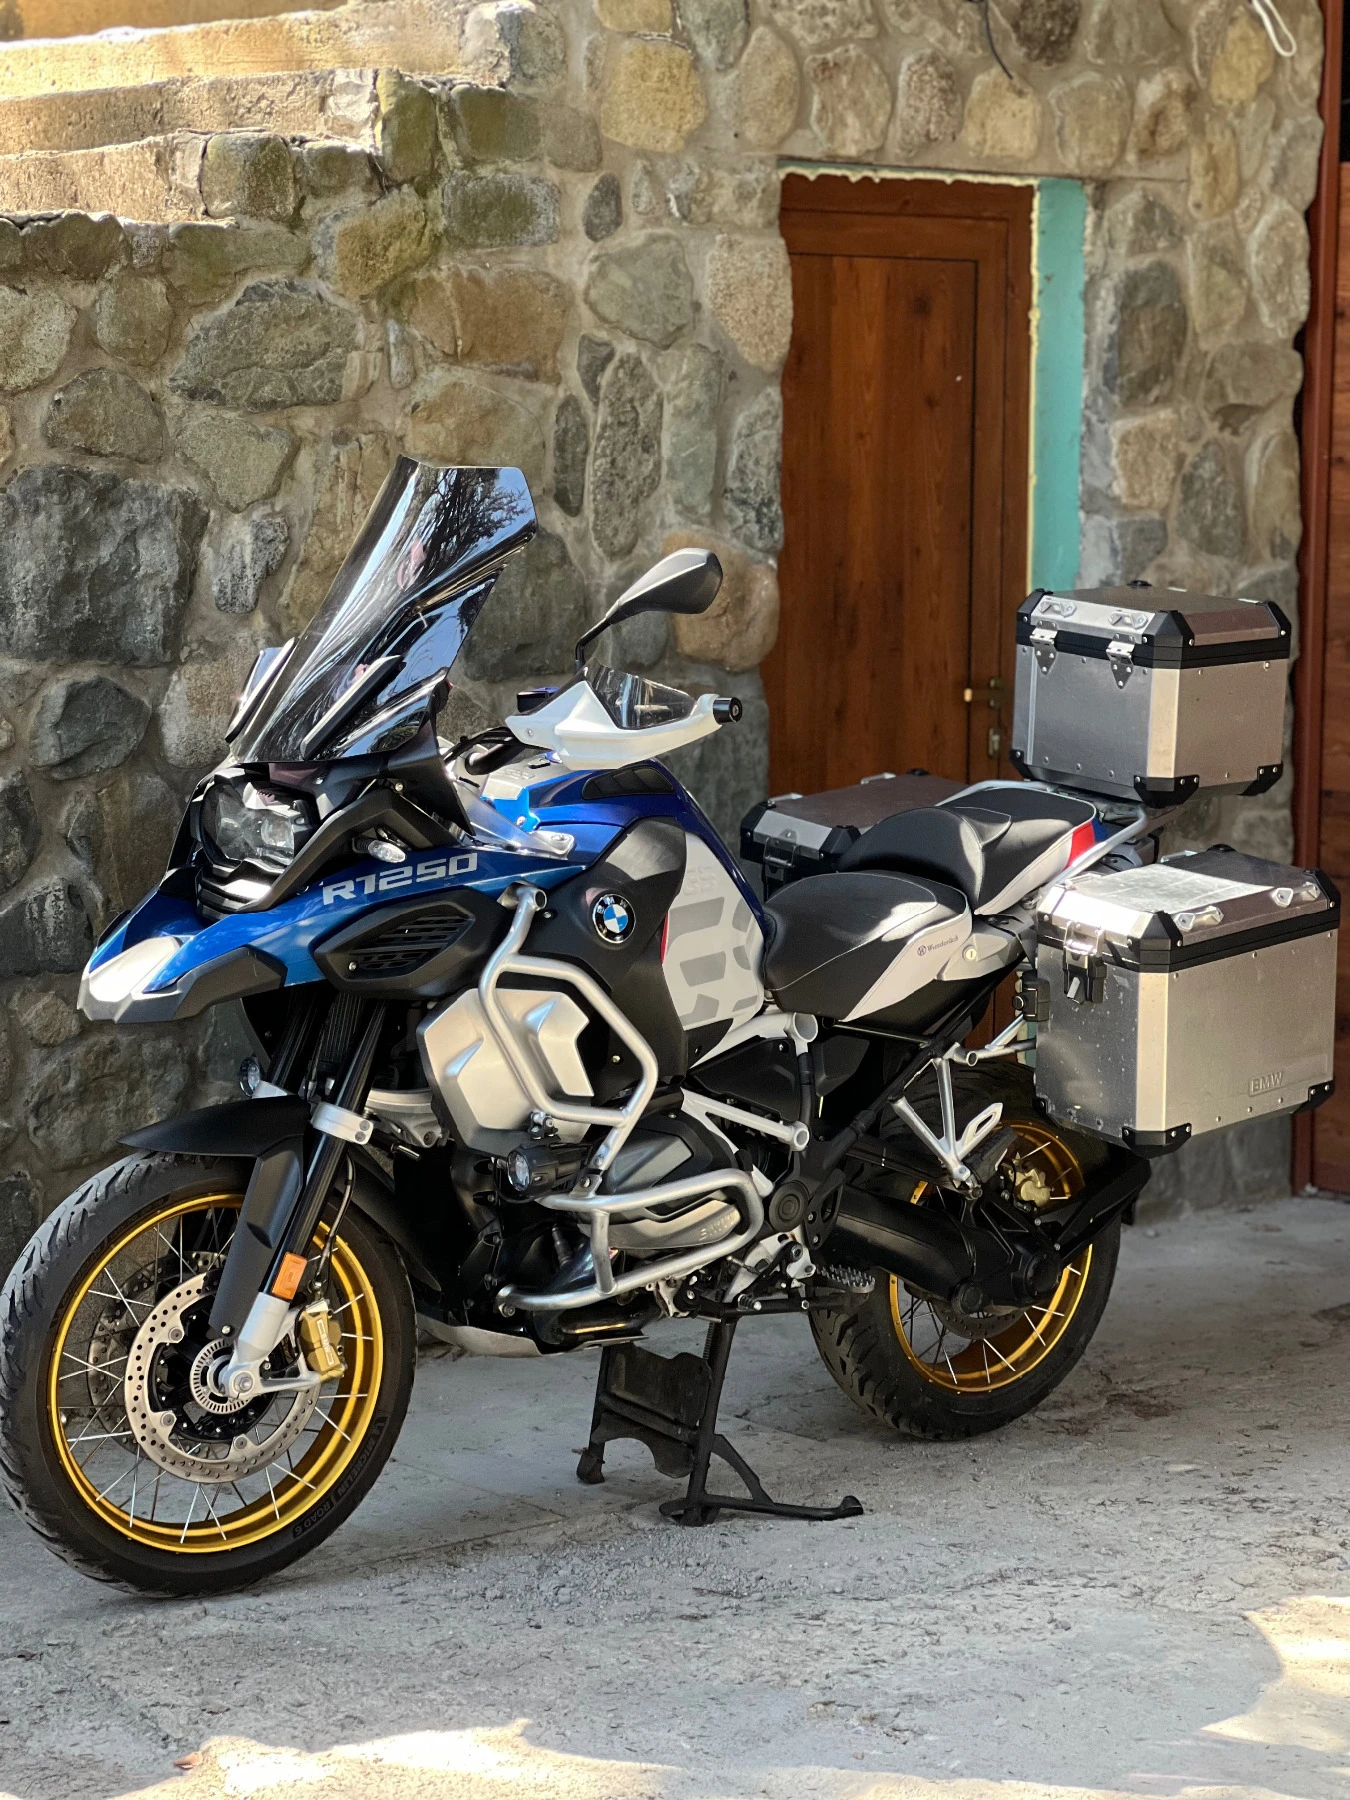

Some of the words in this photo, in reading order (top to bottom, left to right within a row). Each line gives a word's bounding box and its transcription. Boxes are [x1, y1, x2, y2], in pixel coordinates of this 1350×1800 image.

[323, 853, 478, 906] R1250
[1250, 1071, 1283, 1093] BMW
[336, 1437, 376, 1496] MICHELIN
[303, 1501, 331, 1529] ROAD
